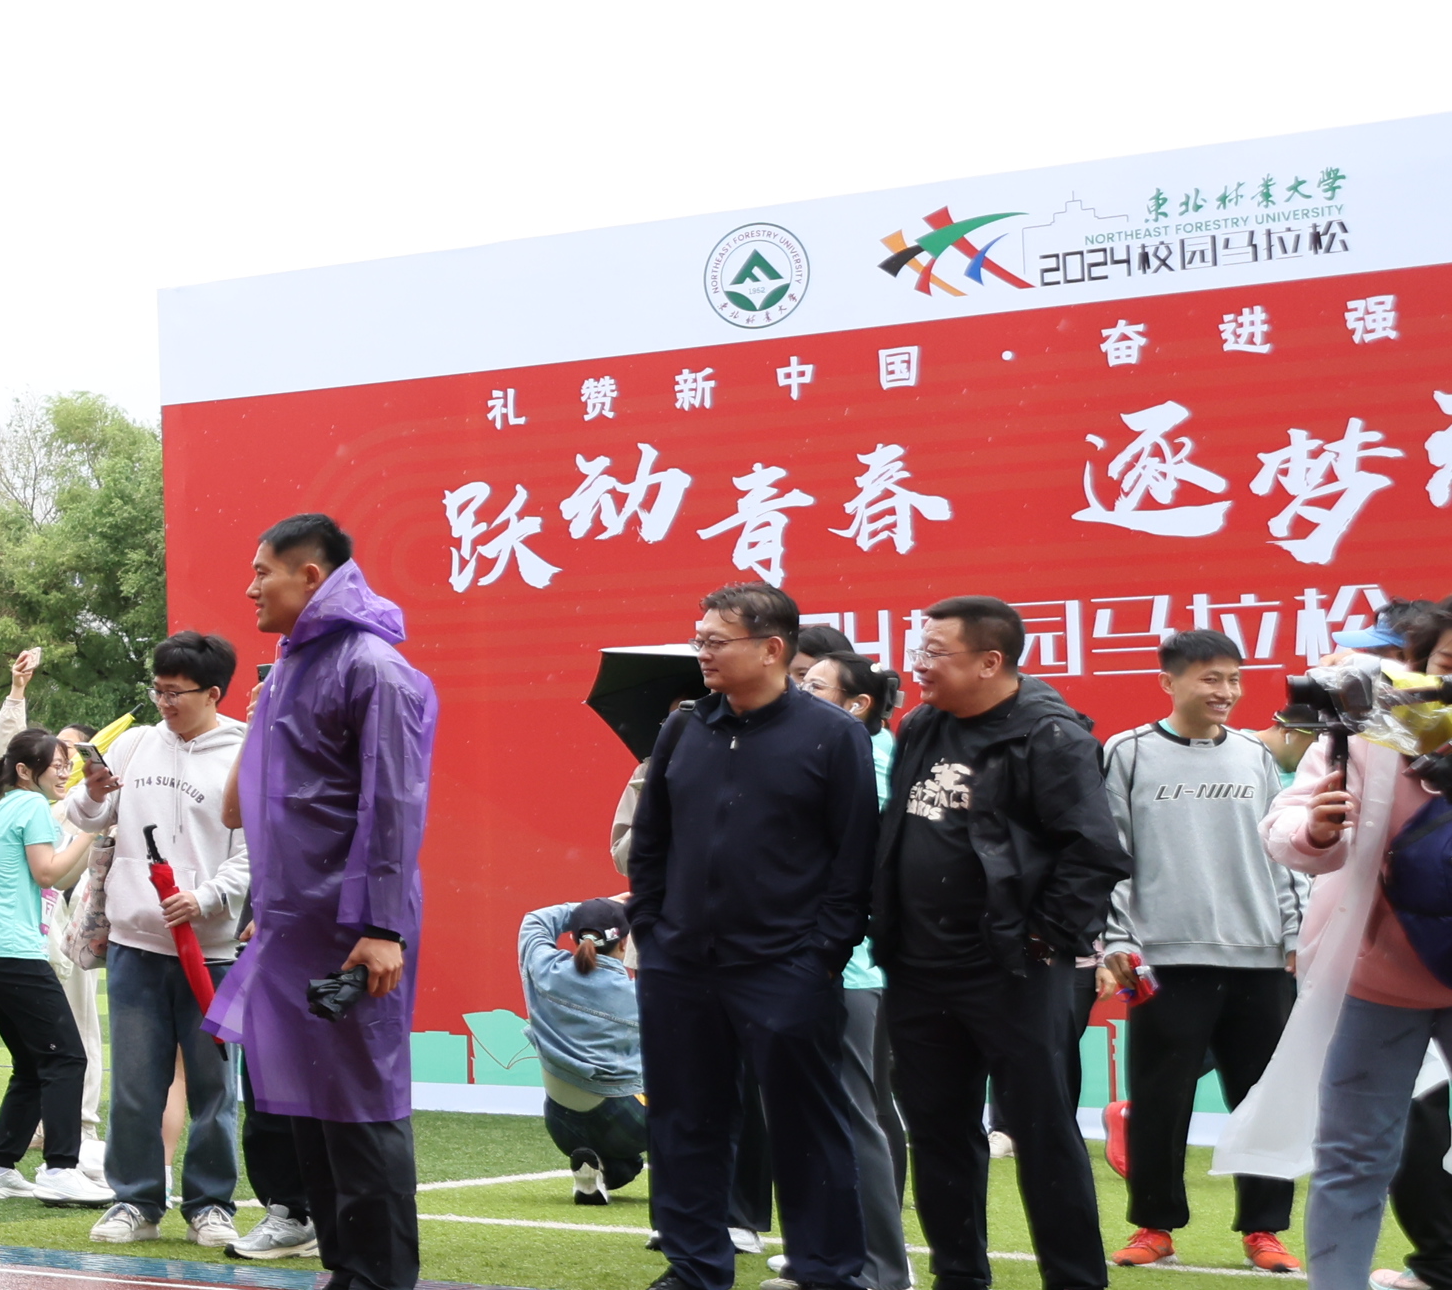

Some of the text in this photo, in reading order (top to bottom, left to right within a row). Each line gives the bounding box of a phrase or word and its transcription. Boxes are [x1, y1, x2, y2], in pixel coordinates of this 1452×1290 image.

[1084, 204, 1345, 246] NORTHEAST FORESTRY UNIVERSITY
[710, 229, 803, 294] NORTHEAST FORESTRY UNIVERSITY
[1039, 219, 1350, 287] 2024校园马拉松
[442, 442, 952, 593] 跃动青春
[134, 778, 152, 790] 714
[1153, 782, 1255, 801] LI-NING
